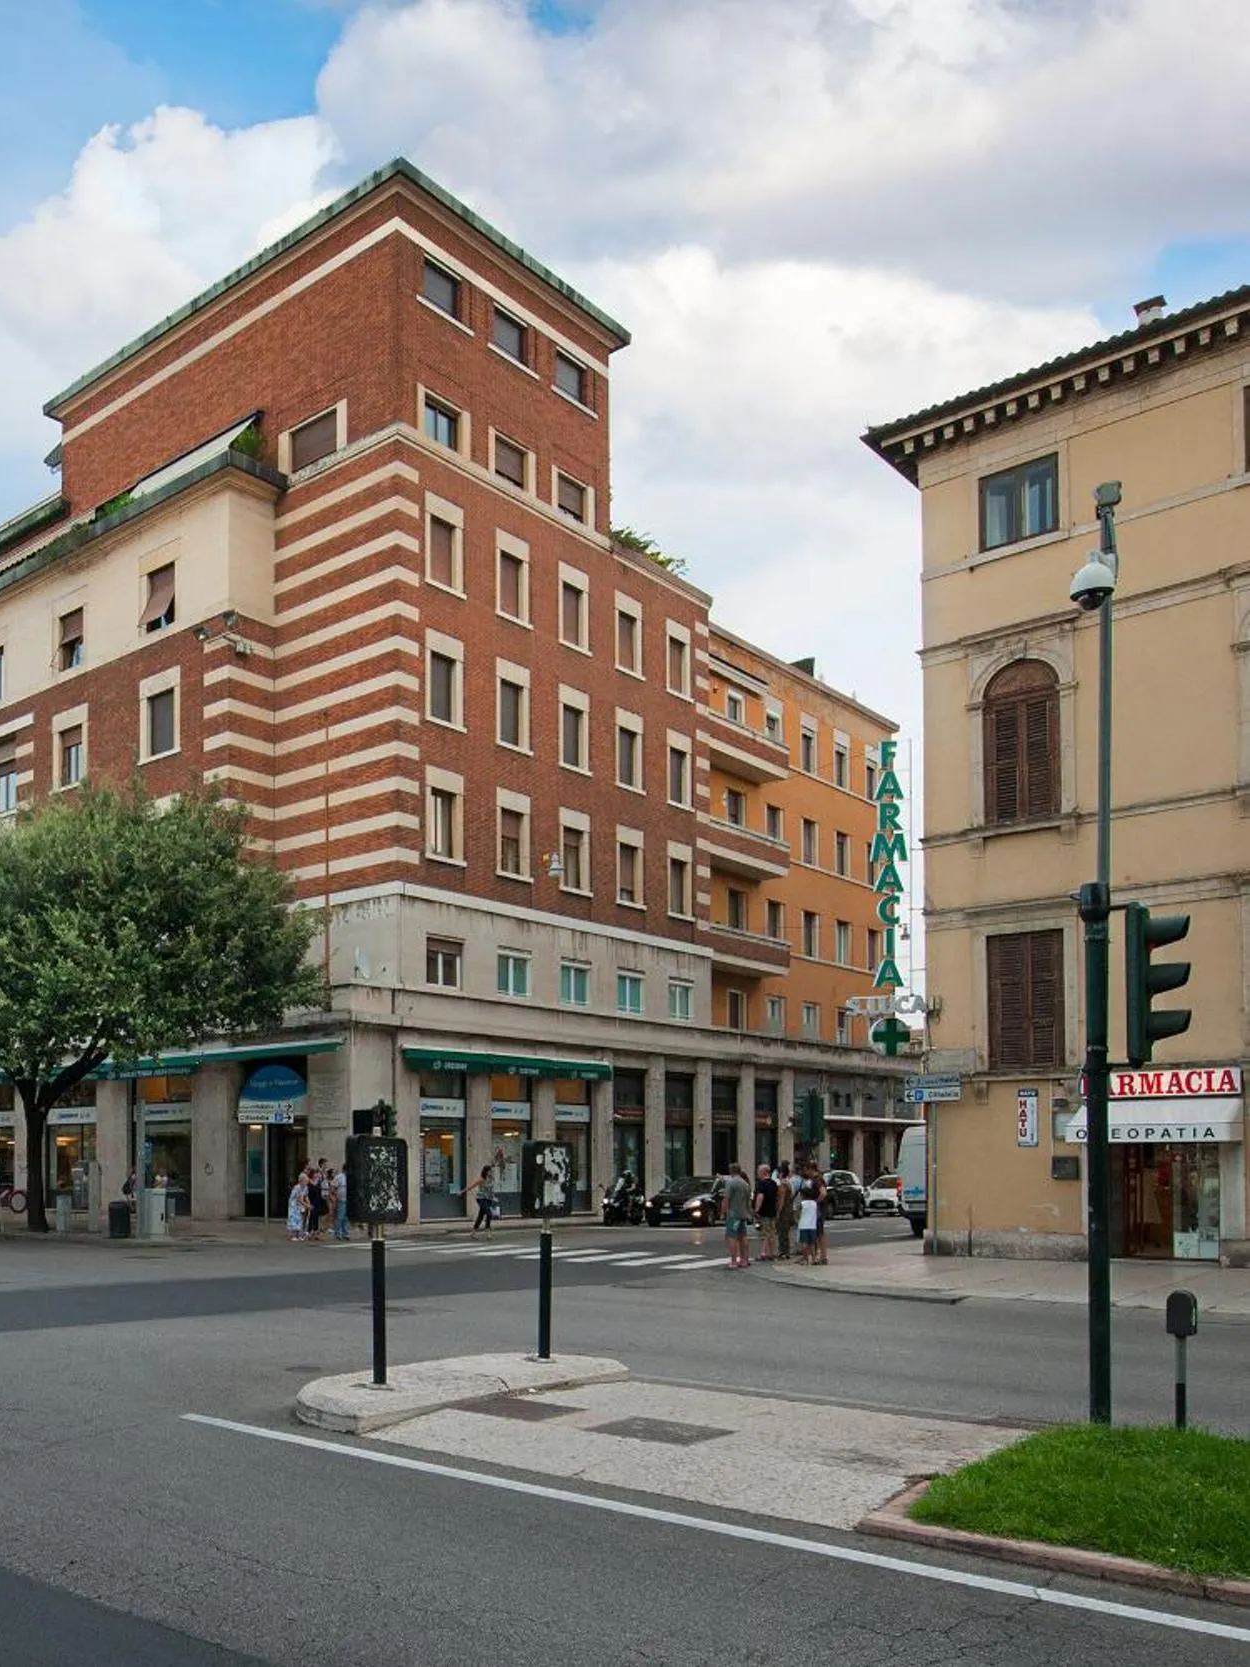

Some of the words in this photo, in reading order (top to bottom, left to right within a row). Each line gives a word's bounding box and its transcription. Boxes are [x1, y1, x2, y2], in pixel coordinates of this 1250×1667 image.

[870, 741, 908, 988] FARMACIA
[1081, 1070, 1238, 1097] RMACIA
[1019, 1100, 1027, 1137] HATU
[1076, 1127, 1215, 1140] OEOPATIA
